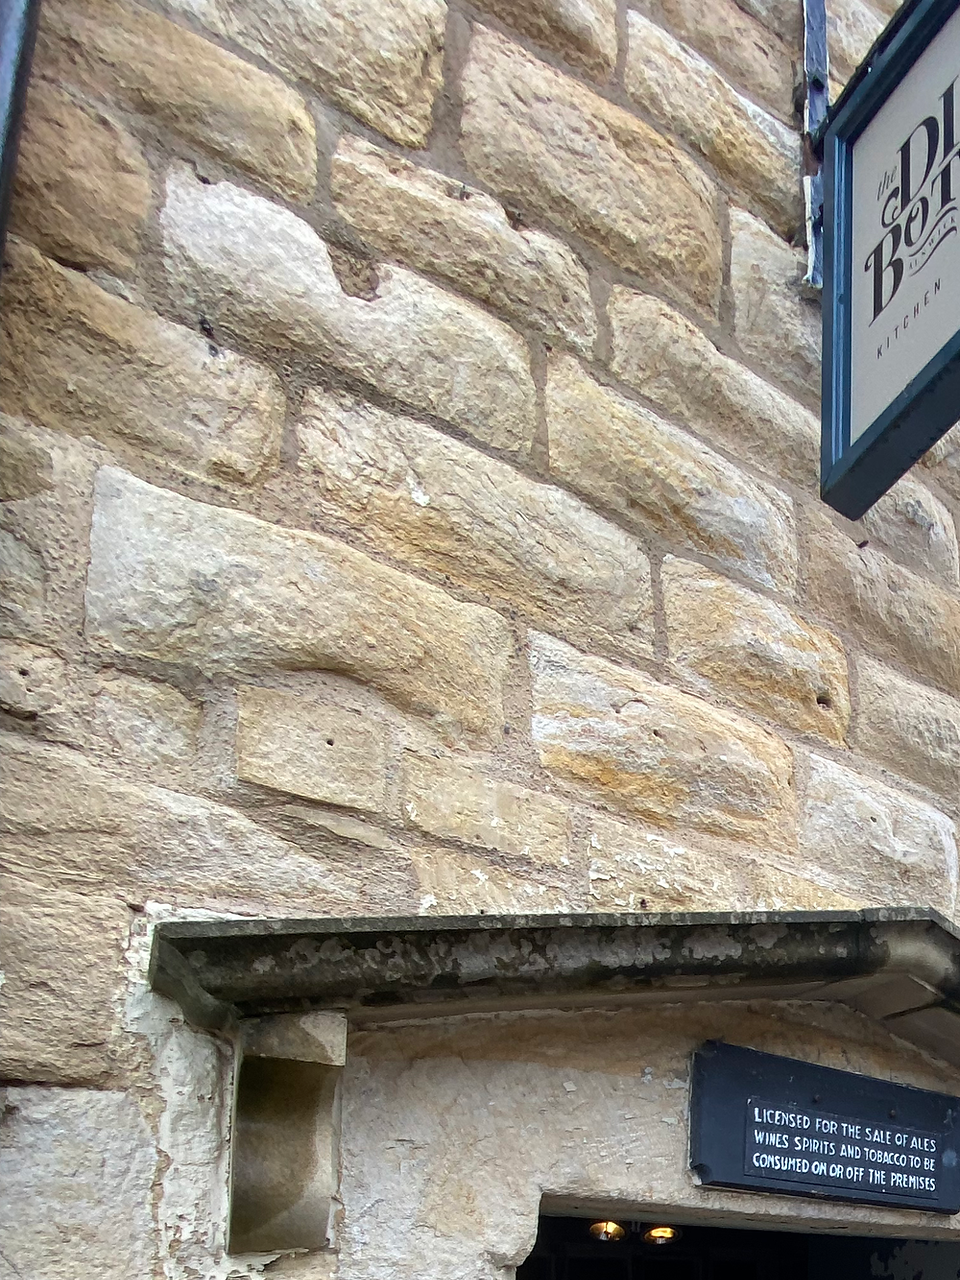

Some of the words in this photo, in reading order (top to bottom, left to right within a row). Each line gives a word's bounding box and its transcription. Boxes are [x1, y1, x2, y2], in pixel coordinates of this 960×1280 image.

[877, 166, 898, 201] the
[877, 278, 941, 359] KITCHEN
[754, 1107, 811, 1129] LICENSED
[815, 1118, 838, 1135] FOR
[841, 1122, 861, 1139] THE
[865, 1127, 892, 1145] SALE
[895, 1132, 909, 1147] OF
[910, 1136, 936, 1152] ALES
[754, 1129, 789, 1148] WINES
[794, 1136, 836, 1156] SPIRITS
[839, 1144, 861, 1159] AND
[863, 1147, 907, 1167] TOBACCO
[908, 1155, 921, 1169] TO
[924, 1157, 936, 1172] BE
[752, 1152, 810, 1173] CONSUMED
[811, 1161, 827, 1176] ON
[829, 1163, 844, 1179] OR
[846, 1166, 865, 1182] OFF
[868, 1168, 886, 1185] THE
[890, 1172, 936, 1191] PREMISES
